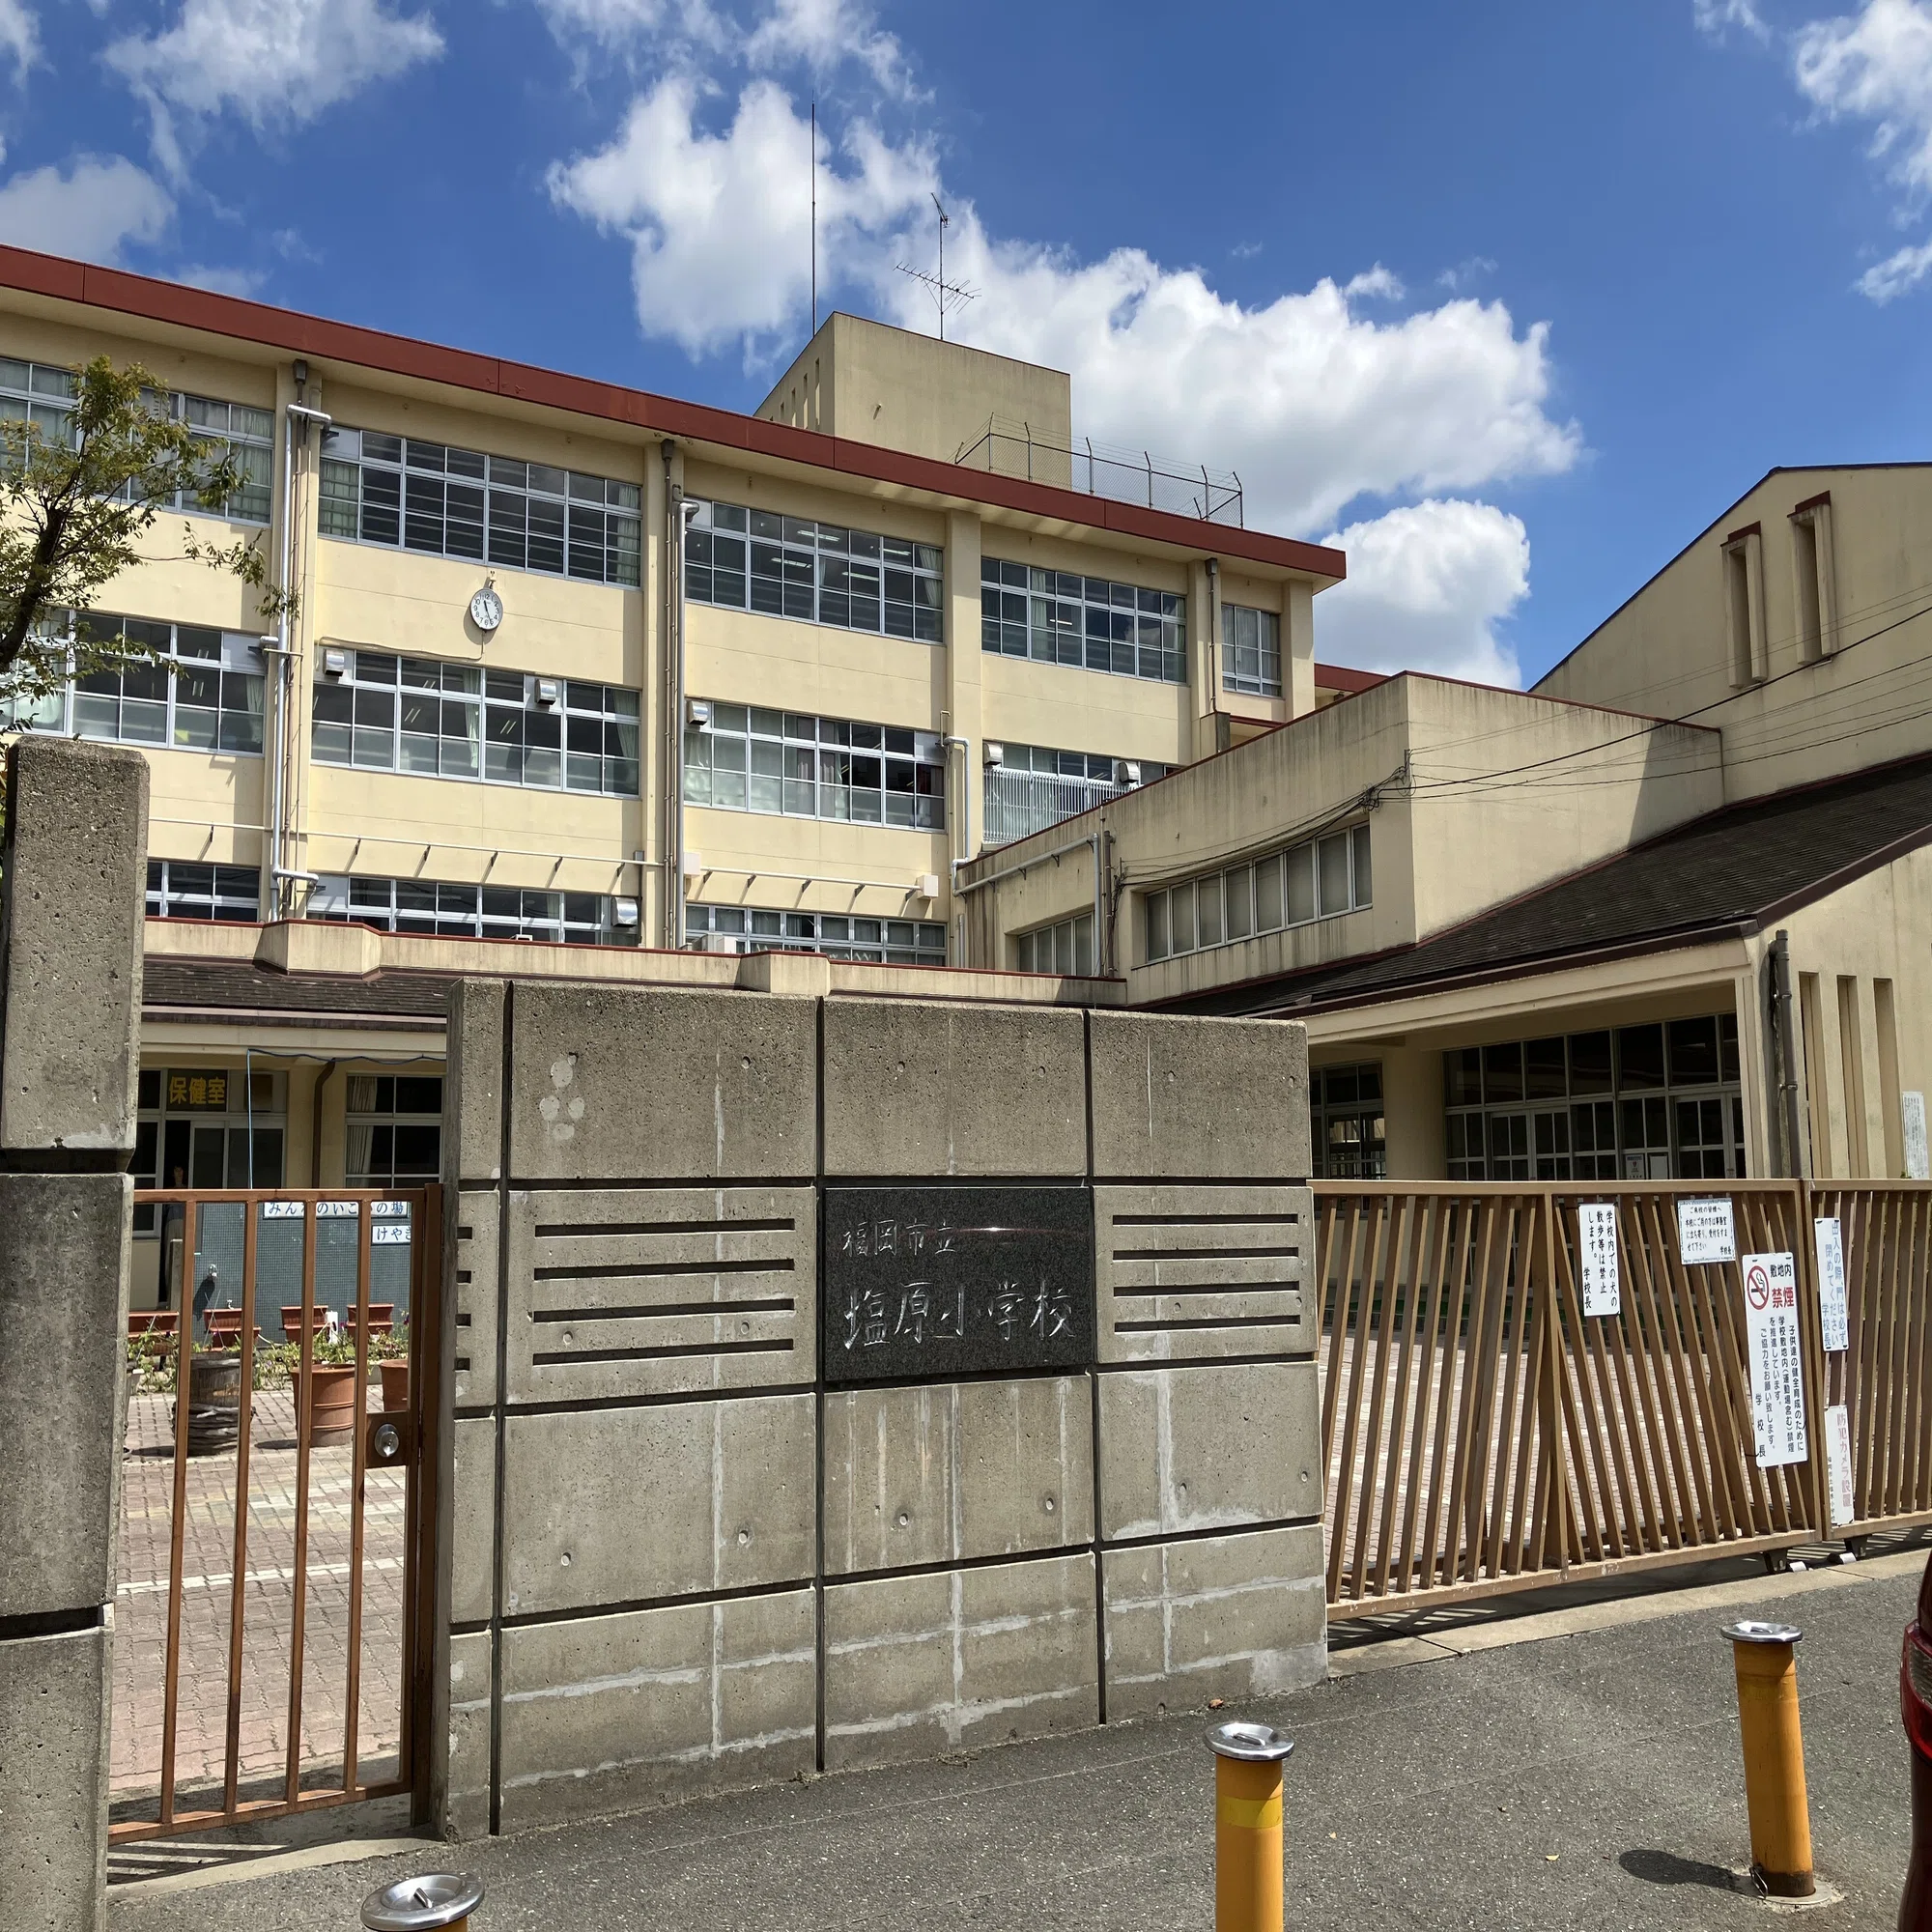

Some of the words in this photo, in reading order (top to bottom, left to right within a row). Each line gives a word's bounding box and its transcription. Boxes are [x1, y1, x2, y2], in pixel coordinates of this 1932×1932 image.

[169, 1076, 226, 1105] 保健室
[842, 1217, 956, 1257] 福岡市立
[1588, 1211, 1597, 1258] します。
[1597, 1210, 1607, 1293] 散歩等は禁止
[1605, 1210, 1617, 1307] 学校内での犬の
[1770, 1264, 1792, 1278] 敷地内
[1583, 1267, 1592, 1309] 学校長
[1772, 1287, 1795, 1309] 禁煙
[1825, 1243, 1838, 1346] 閉めてください
[843, 1278, 1076, 1350] 塩原小学校
[1822, 1303, 1832, 1347] 学校長
[1836, 1413, 1852, 1508] 防犯カメラ設置
